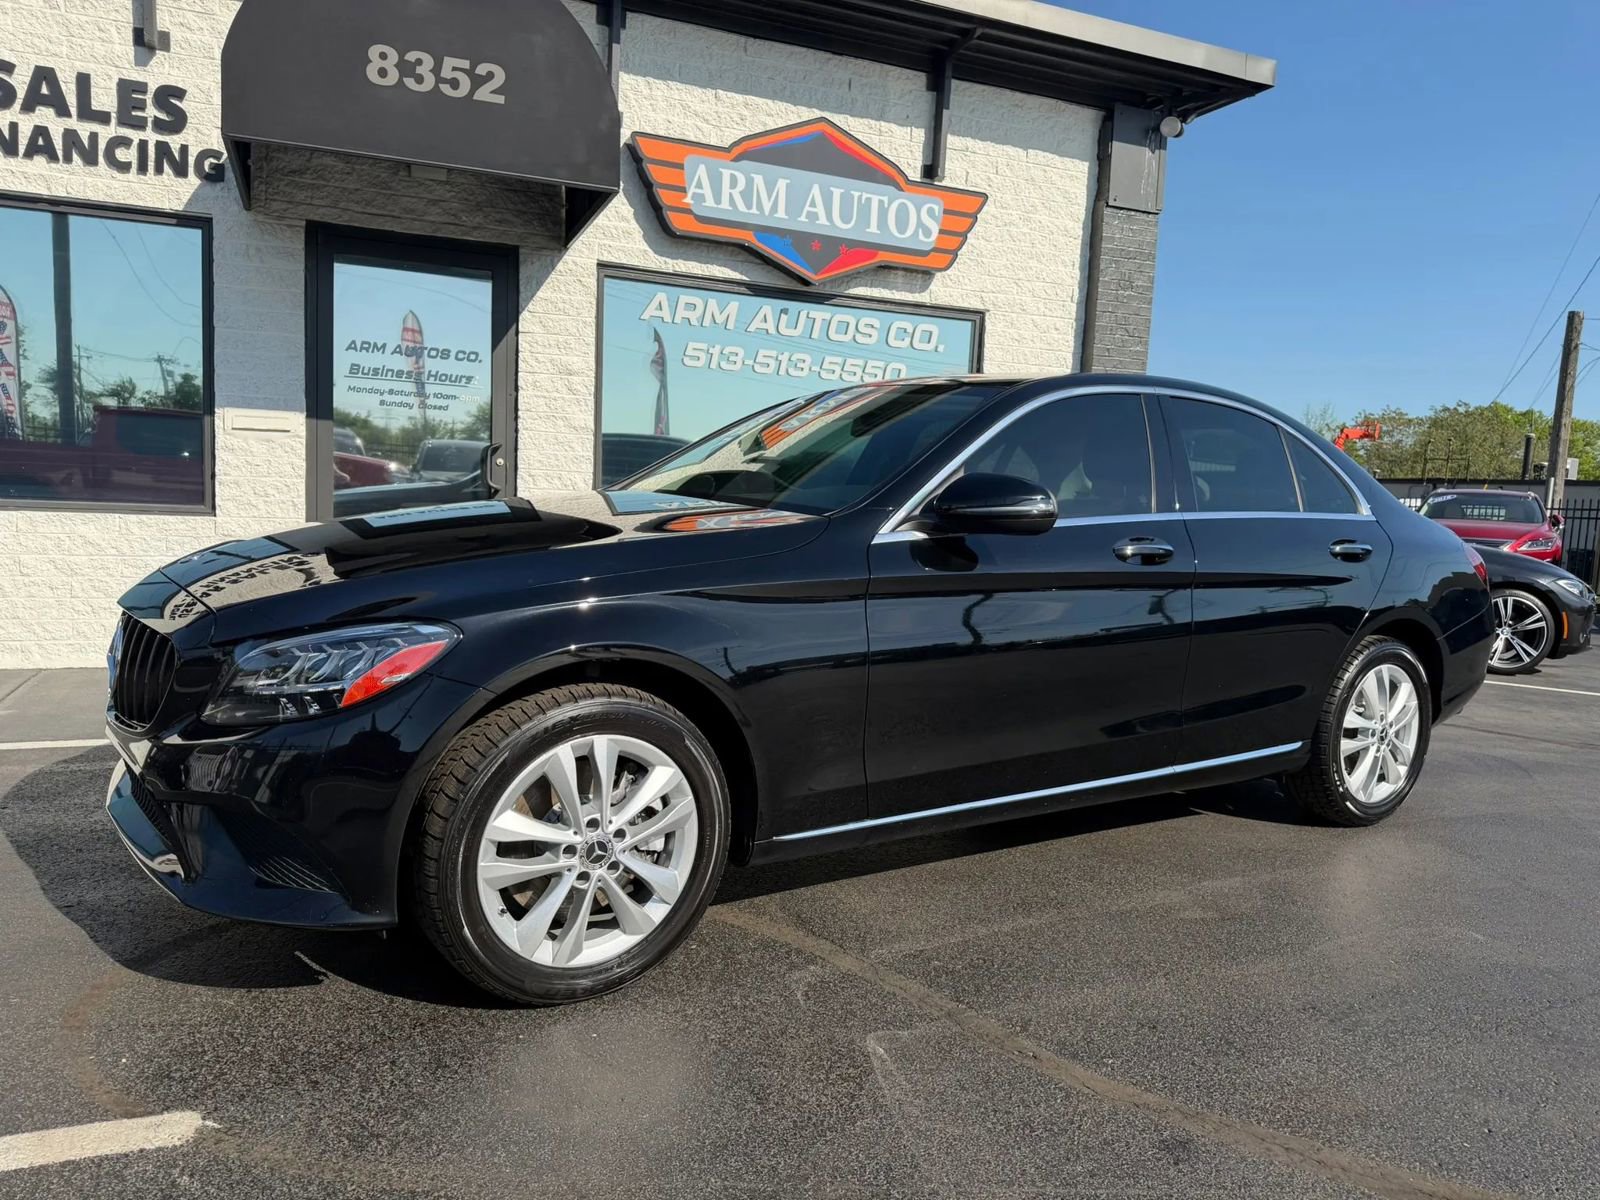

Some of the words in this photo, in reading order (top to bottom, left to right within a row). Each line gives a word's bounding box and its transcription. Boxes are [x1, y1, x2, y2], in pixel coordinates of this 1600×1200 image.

[366, 44, 507, 104] 8352
[682, 163, 790, 220] ARM
[797, 183, 941, 243] AUTOS
[640, 292, 739, 331] ARM
[746, 305, 880, 345] AUTOS
[886, 321, 945, 353] CO.
[345, 339, 387, 355] ARM
[391, 344, 451, 360] AUTOS
[454, 350, 483, 364] CO.
[682, 341, 908, 383] 513-513-5550
[348, 363, 424, 381] Business
[347, 385, 431, 399] Monday-Saturday
[378, 399, 414, 410] Sunday
[418, 401, 449, 411] Closed
